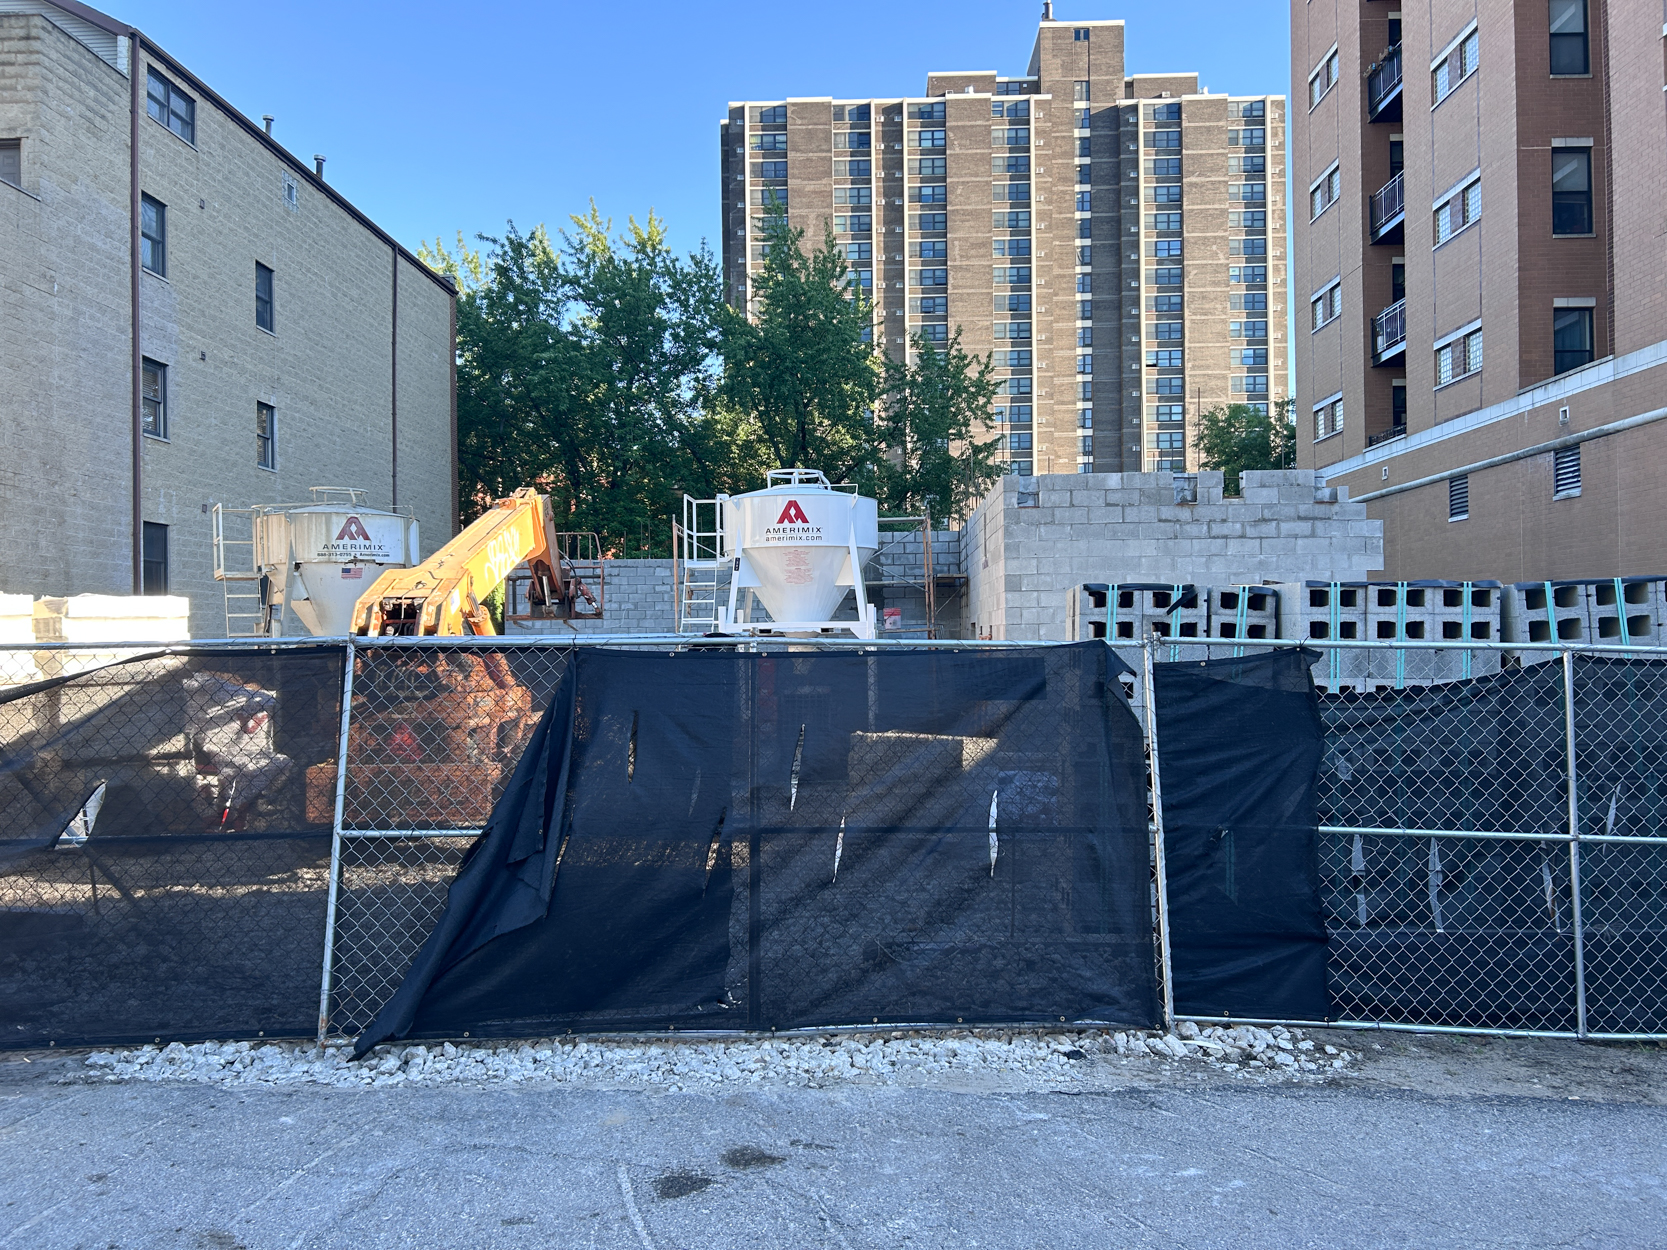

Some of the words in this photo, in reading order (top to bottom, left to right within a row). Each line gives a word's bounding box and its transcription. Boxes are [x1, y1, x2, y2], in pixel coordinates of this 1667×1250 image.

[765, 526, 822, 534] AMERIMIX
[765, 534, 823, 542] amerimix.com
[322, 543, 384, 551] AMERIMIX
